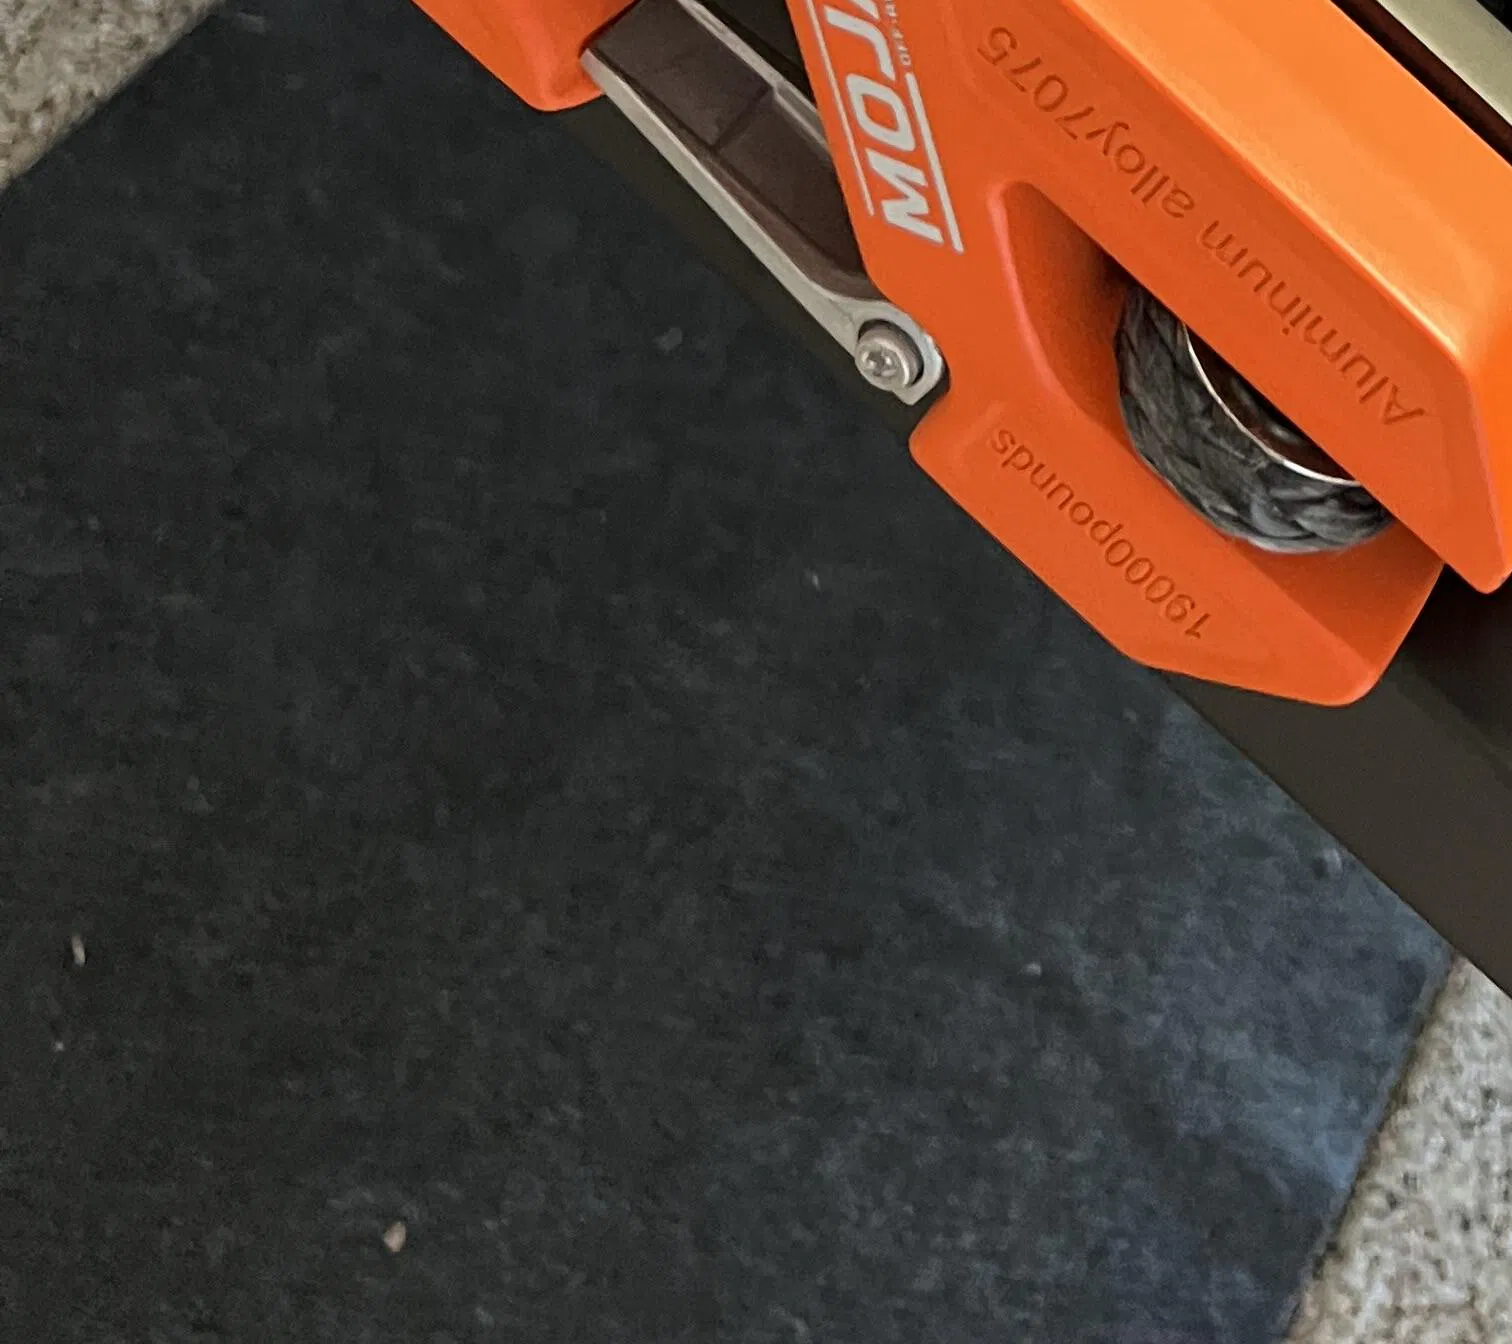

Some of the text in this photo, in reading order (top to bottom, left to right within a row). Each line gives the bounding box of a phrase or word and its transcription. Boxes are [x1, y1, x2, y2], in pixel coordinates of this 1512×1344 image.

[977, 27, 1425, 426] Aluminum alloy7075
[990, 429, 1211, 639] 19000pounds
